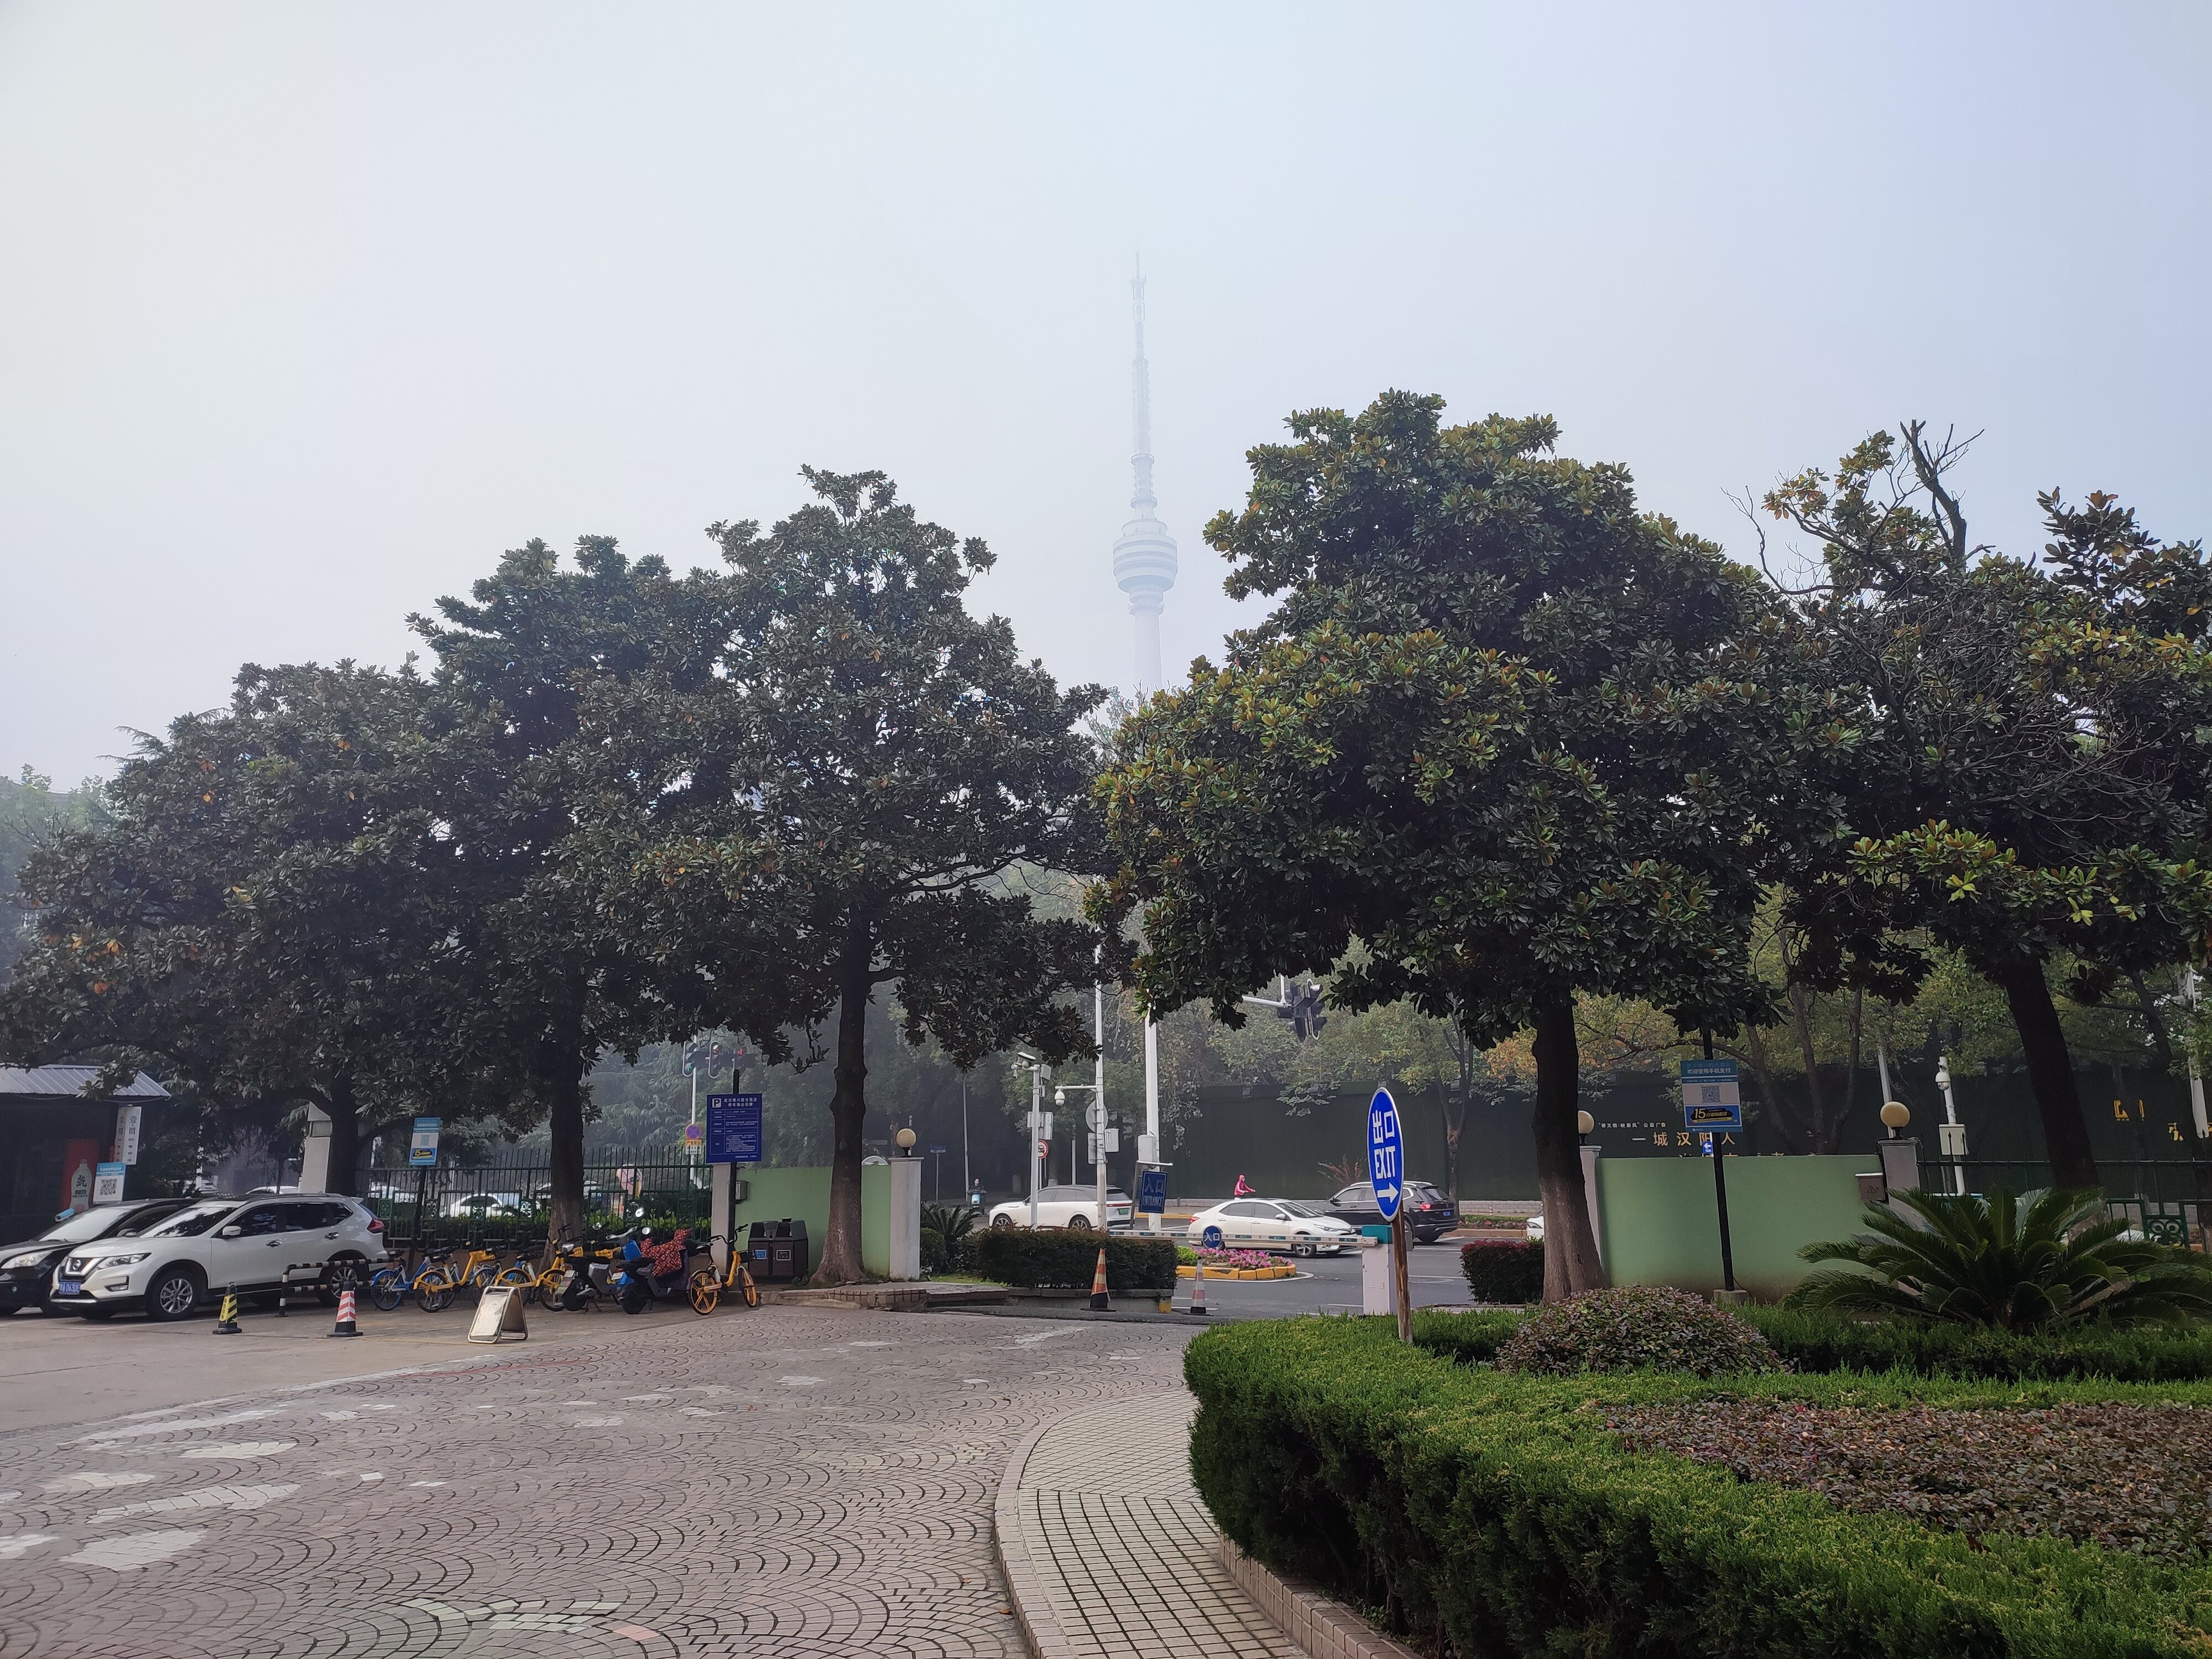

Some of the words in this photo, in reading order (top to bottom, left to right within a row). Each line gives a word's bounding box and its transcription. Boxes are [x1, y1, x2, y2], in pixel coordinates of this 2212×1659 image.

[1372, 1109, 1395, 1144] 出口
[1374, 1145, 1395, 1180] EXIT
[1144, 1177, 1164, 1193] 入口
[1142, 1195, 1163, 1207] ENTRANCE
[1204, 1232, 1220, 1242] 入口
